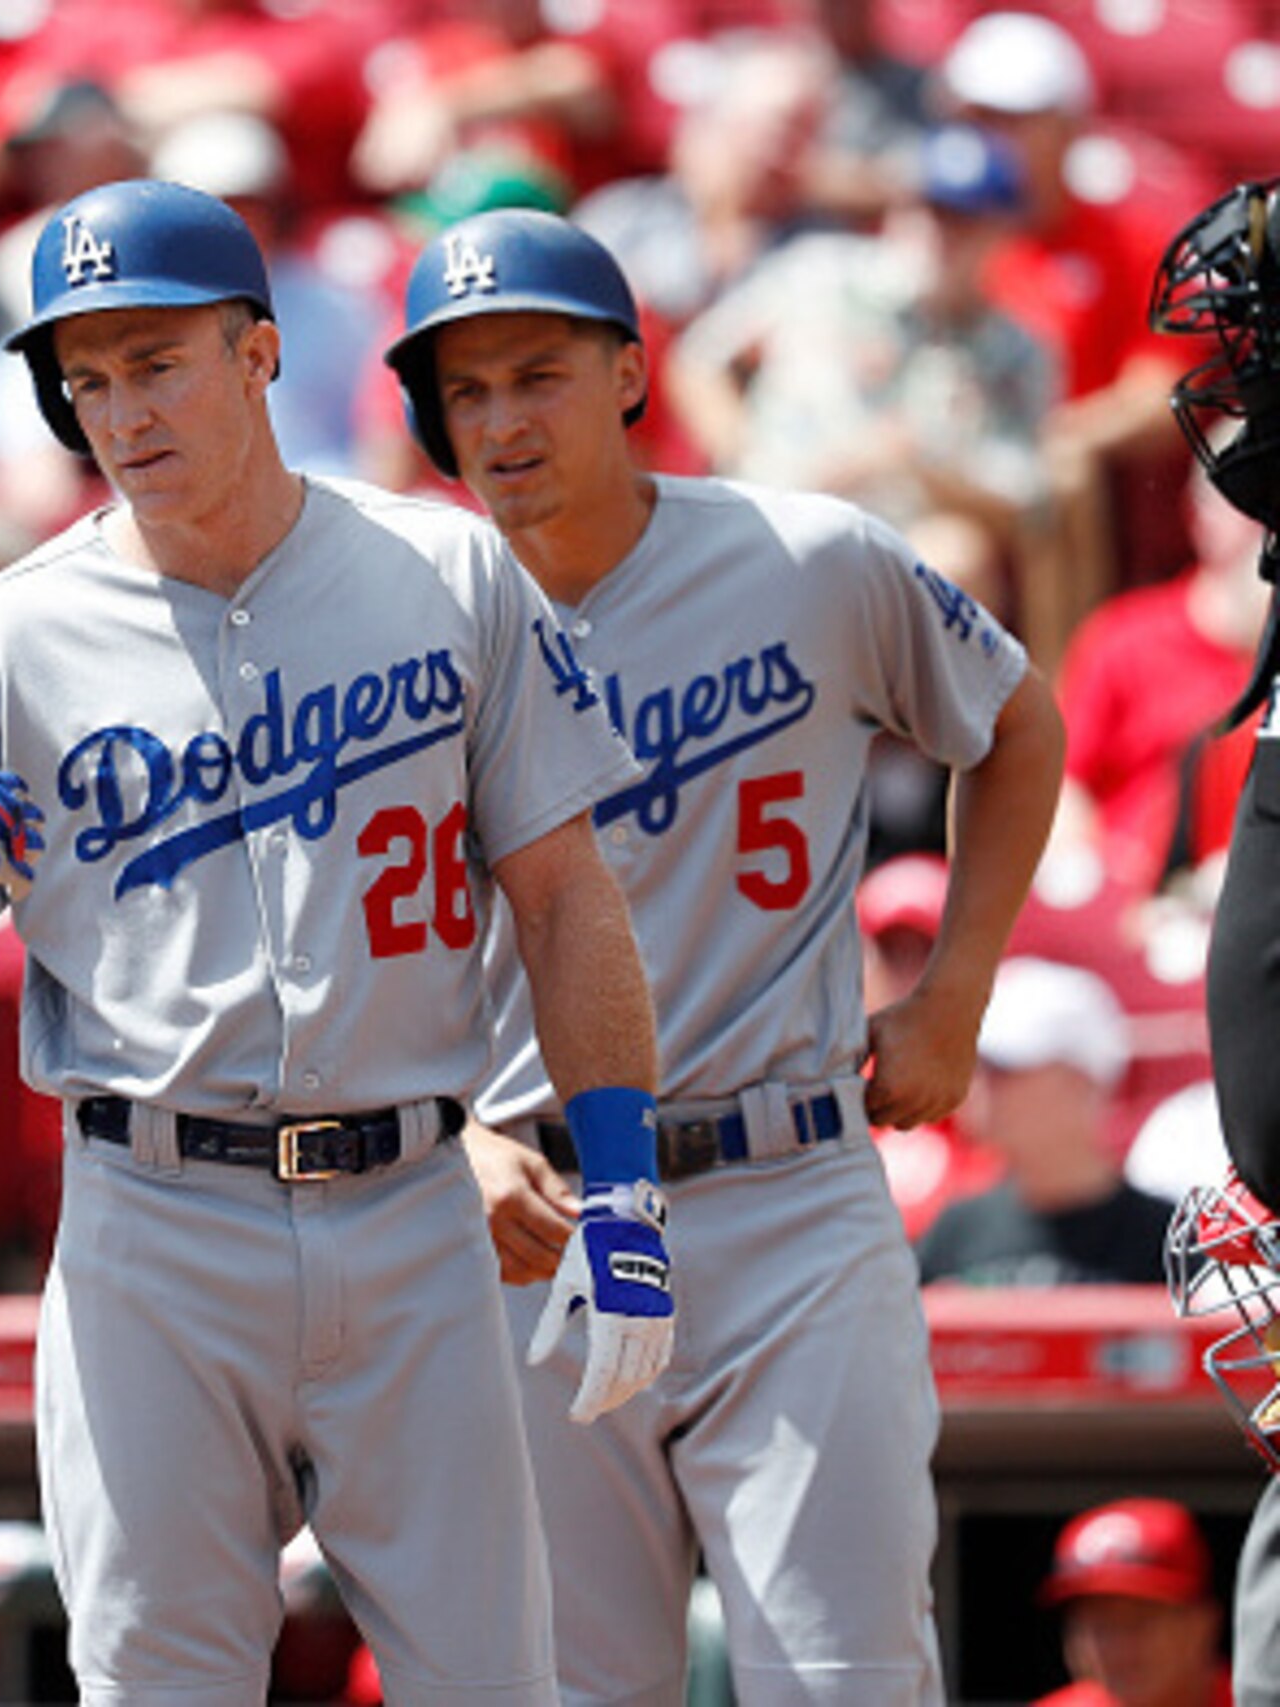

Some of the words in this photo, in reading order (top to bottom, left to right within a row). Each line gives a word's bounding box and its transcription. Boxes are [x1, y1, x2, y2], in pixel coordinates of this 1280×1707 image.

[61, 216, 113, 283] LA
[443, 236, 496, 295] LA
[57, 648, 467, 900] Dodgers
[737, 769, 811, 911] 5
[357, 801, 477, 959] 26
